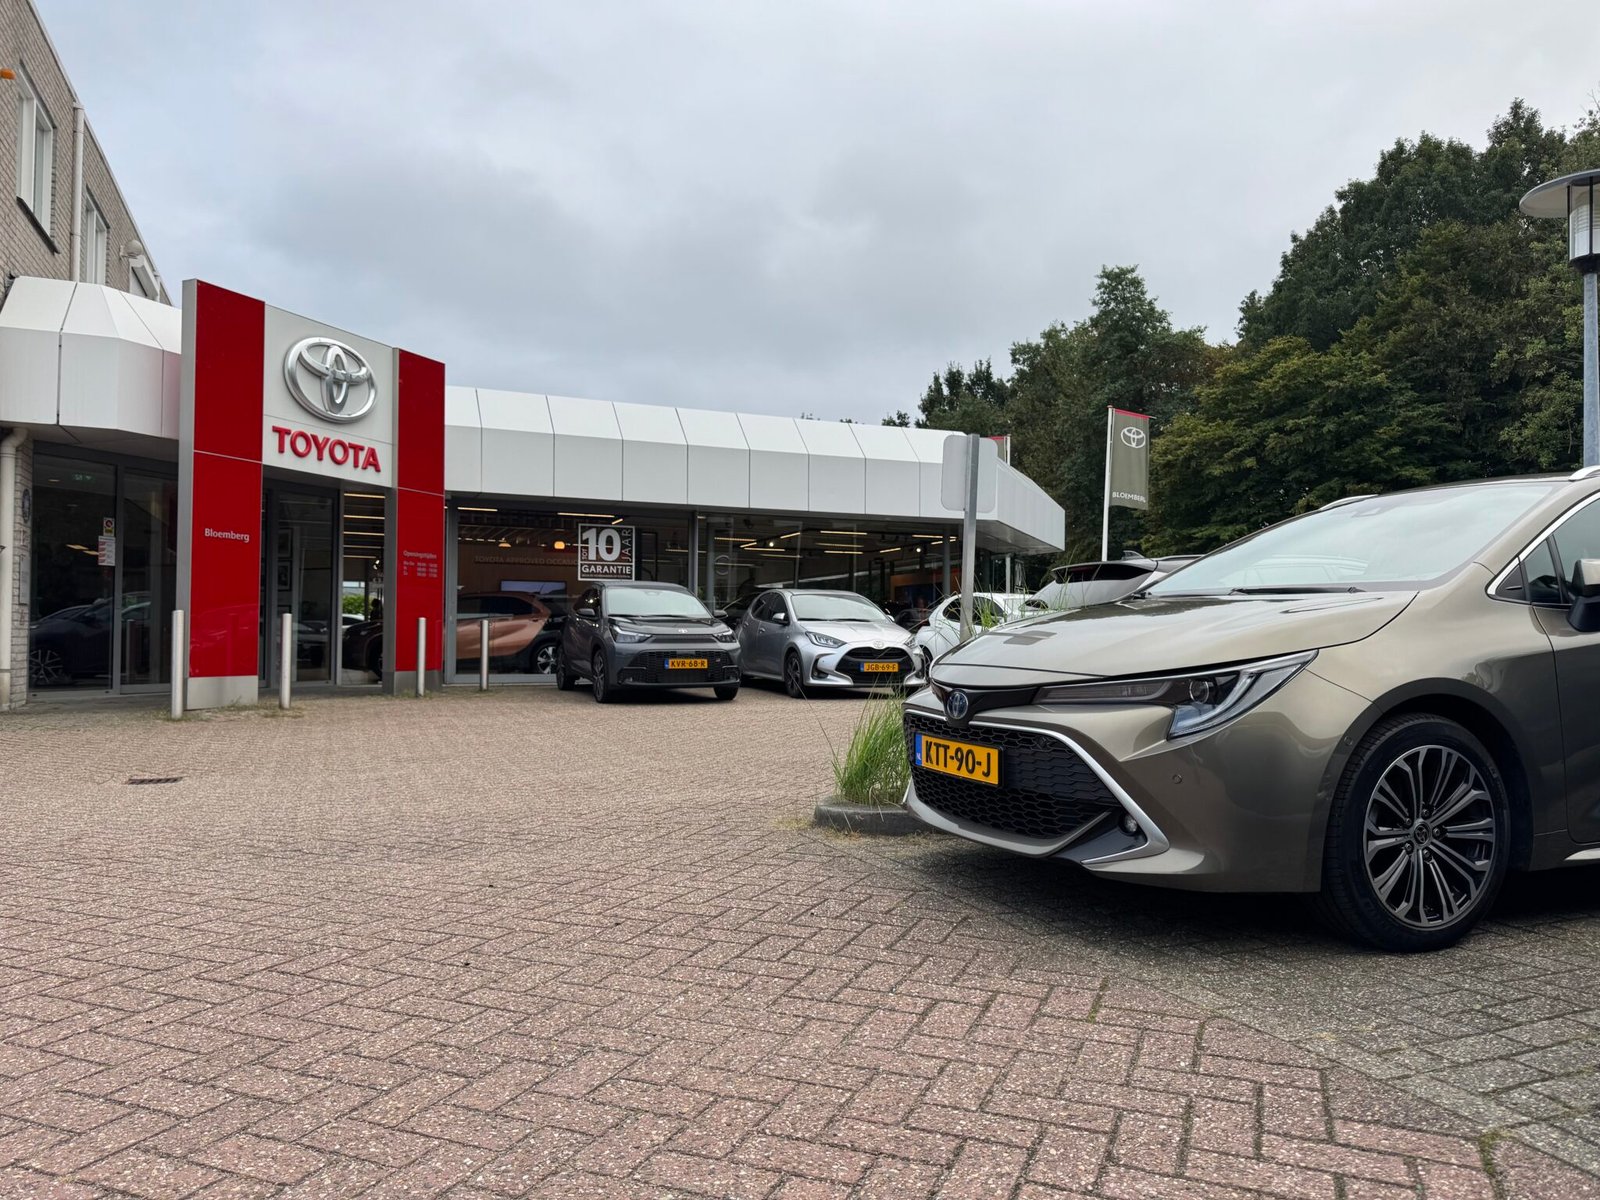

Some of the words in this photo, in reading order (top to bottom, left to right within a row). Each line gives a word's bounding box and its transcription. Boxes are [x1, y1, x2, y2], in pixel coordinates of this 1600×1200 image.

[272, 425, 381, 473] TOYOTA
[1112, 491, 1146, 503] BLOEMBER
[204, 528, 250, 543] Bloemberg
[582, 528, 621, 561] 10
[621, 529, 632, 562] JAAR
[581, 564, 632, 574] GARANTIE
[670, 660, 706, 668] KVR-68-R
[865, 663, 897, 671] JGB-69-F
[925, 740, 991, 777] KTT-90-J
